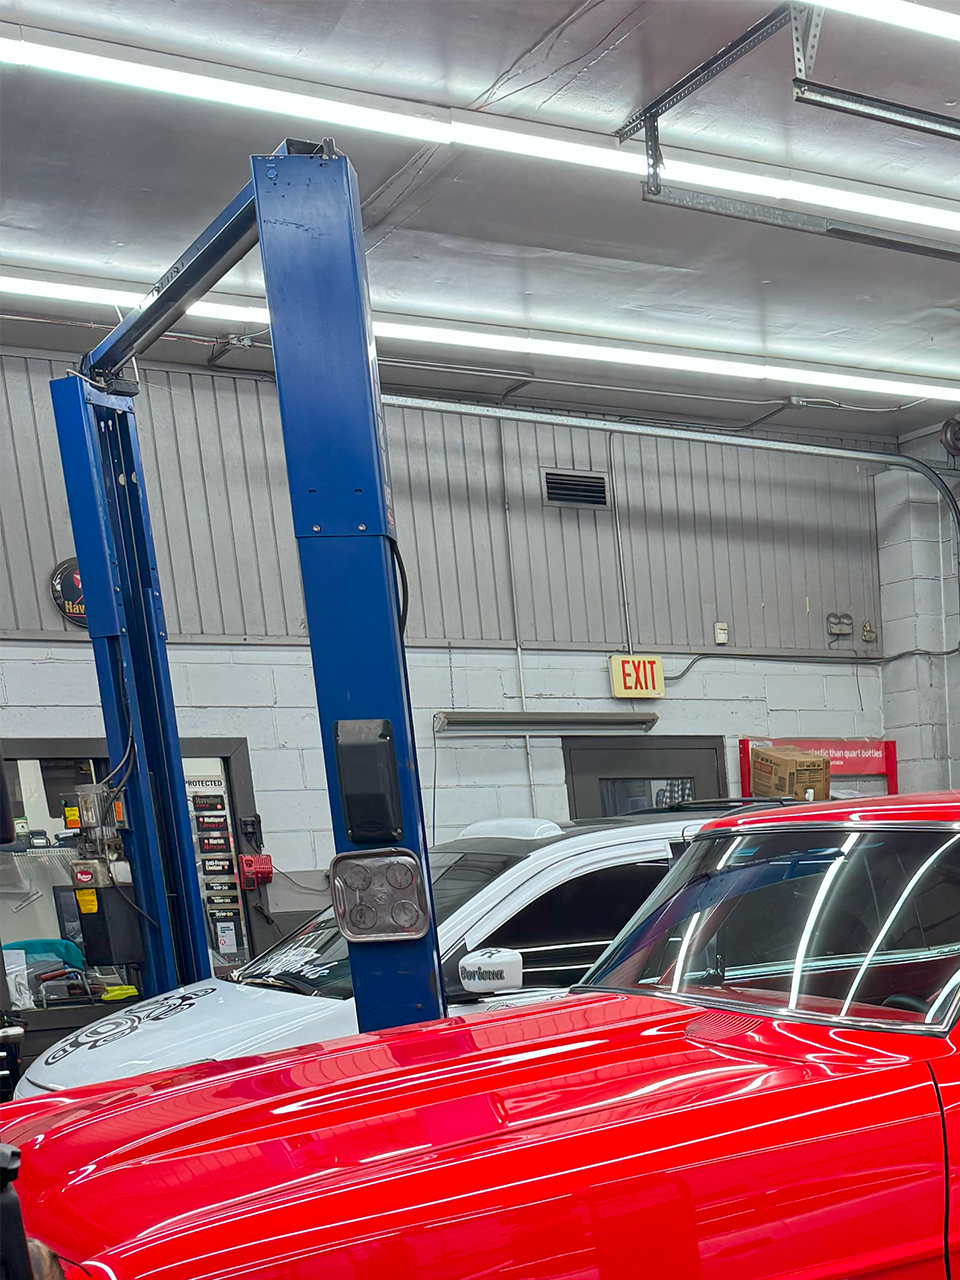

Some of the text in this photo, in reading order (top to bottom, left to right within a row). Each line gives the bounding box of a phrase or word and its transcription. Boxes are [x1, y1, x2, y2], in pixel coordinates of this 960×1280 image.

[621, 659, 656, 690] EXIT
[829, 748, 844, 758] than
[844, 748, 861, 759] quart
[861, 748, 883, 758] bottles
